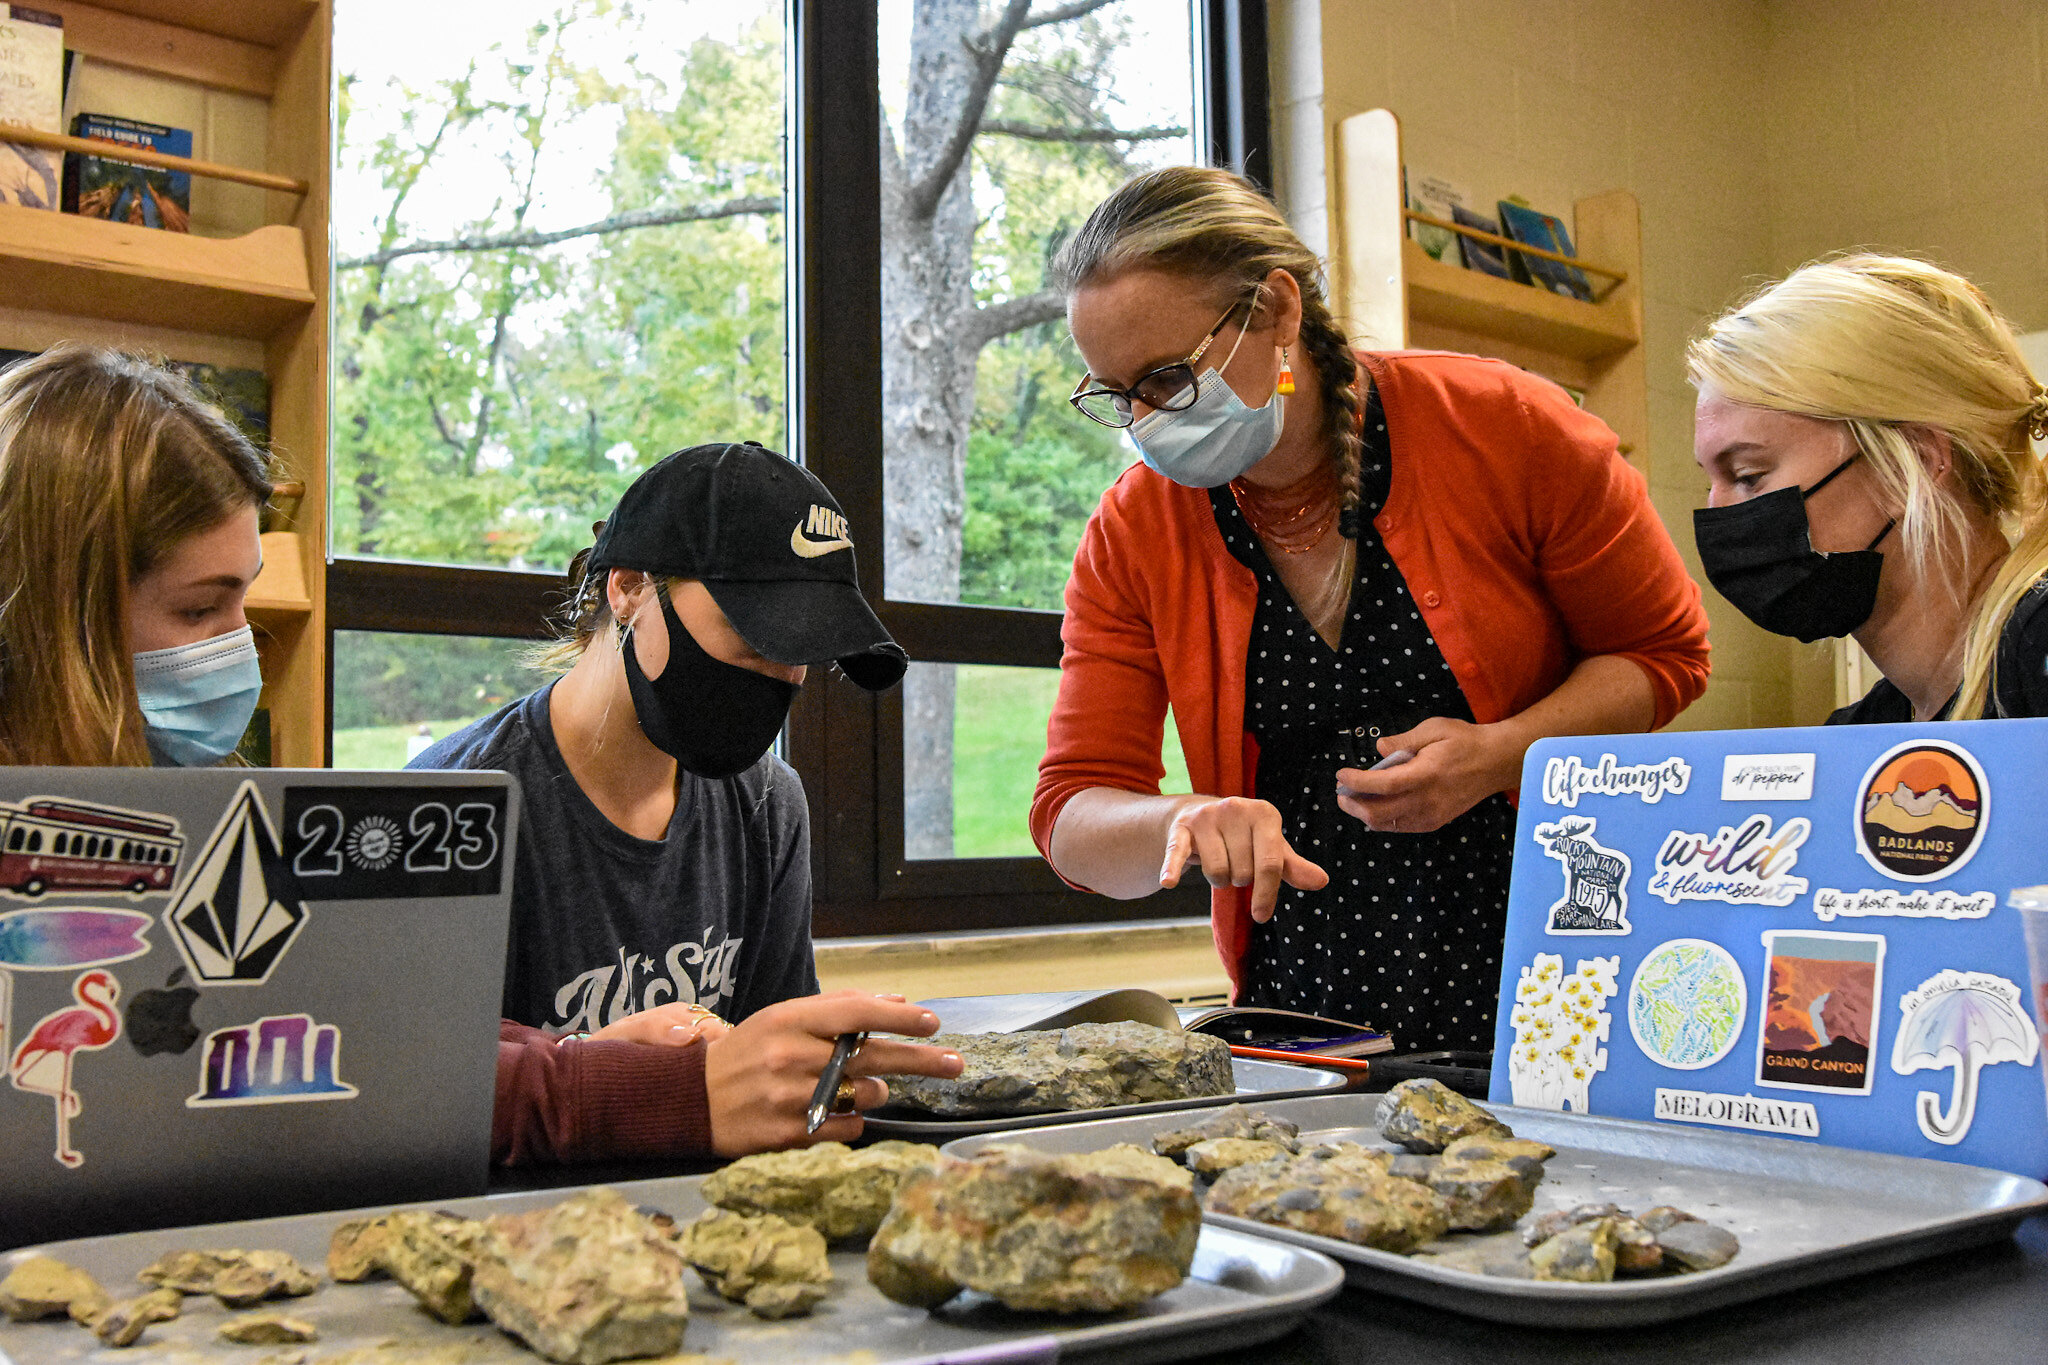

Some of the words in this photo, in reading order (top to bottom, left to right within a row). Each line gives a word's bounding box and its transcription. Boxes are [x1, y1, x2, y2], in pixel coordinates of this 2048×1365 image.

[806, 504, 848, 541] NIKE
[1548, 763, 1588, 801] life
[1592, 759, 1685, 797] changes
[1749, 771, 1804, 791] pepper
[1556, 836, 1590, 858] ROCKY
[1661, 820, 1804, 880] wild
[1878, 836, 1954, 853] BADLANDS
[1569, 853, 1625, 878] MOUNTAIN
[1581, 869, 1614, 883] NATIONAL
[1586, 876, 1608, 887] PARK
[1670, 872, 1801, 900] fluorescent
[1578, 882, 1605, 913] 1915
[1896, 896, 1929, 910] make
[1935, 897, 1951, 910] it
[1952, 898, 1988, 912] sweet
[1556, 902, 1577, 920] ESTES
[1560, 911, 1582, 927] PARK
[1596, 919, 1618, 929] LAKE
[1766, 1054, 1808, 1070] GRAND
[1811, 1058, 1864, 1075] CANYON
[1660, 1093, 1814, 1131] MELODRAMA
